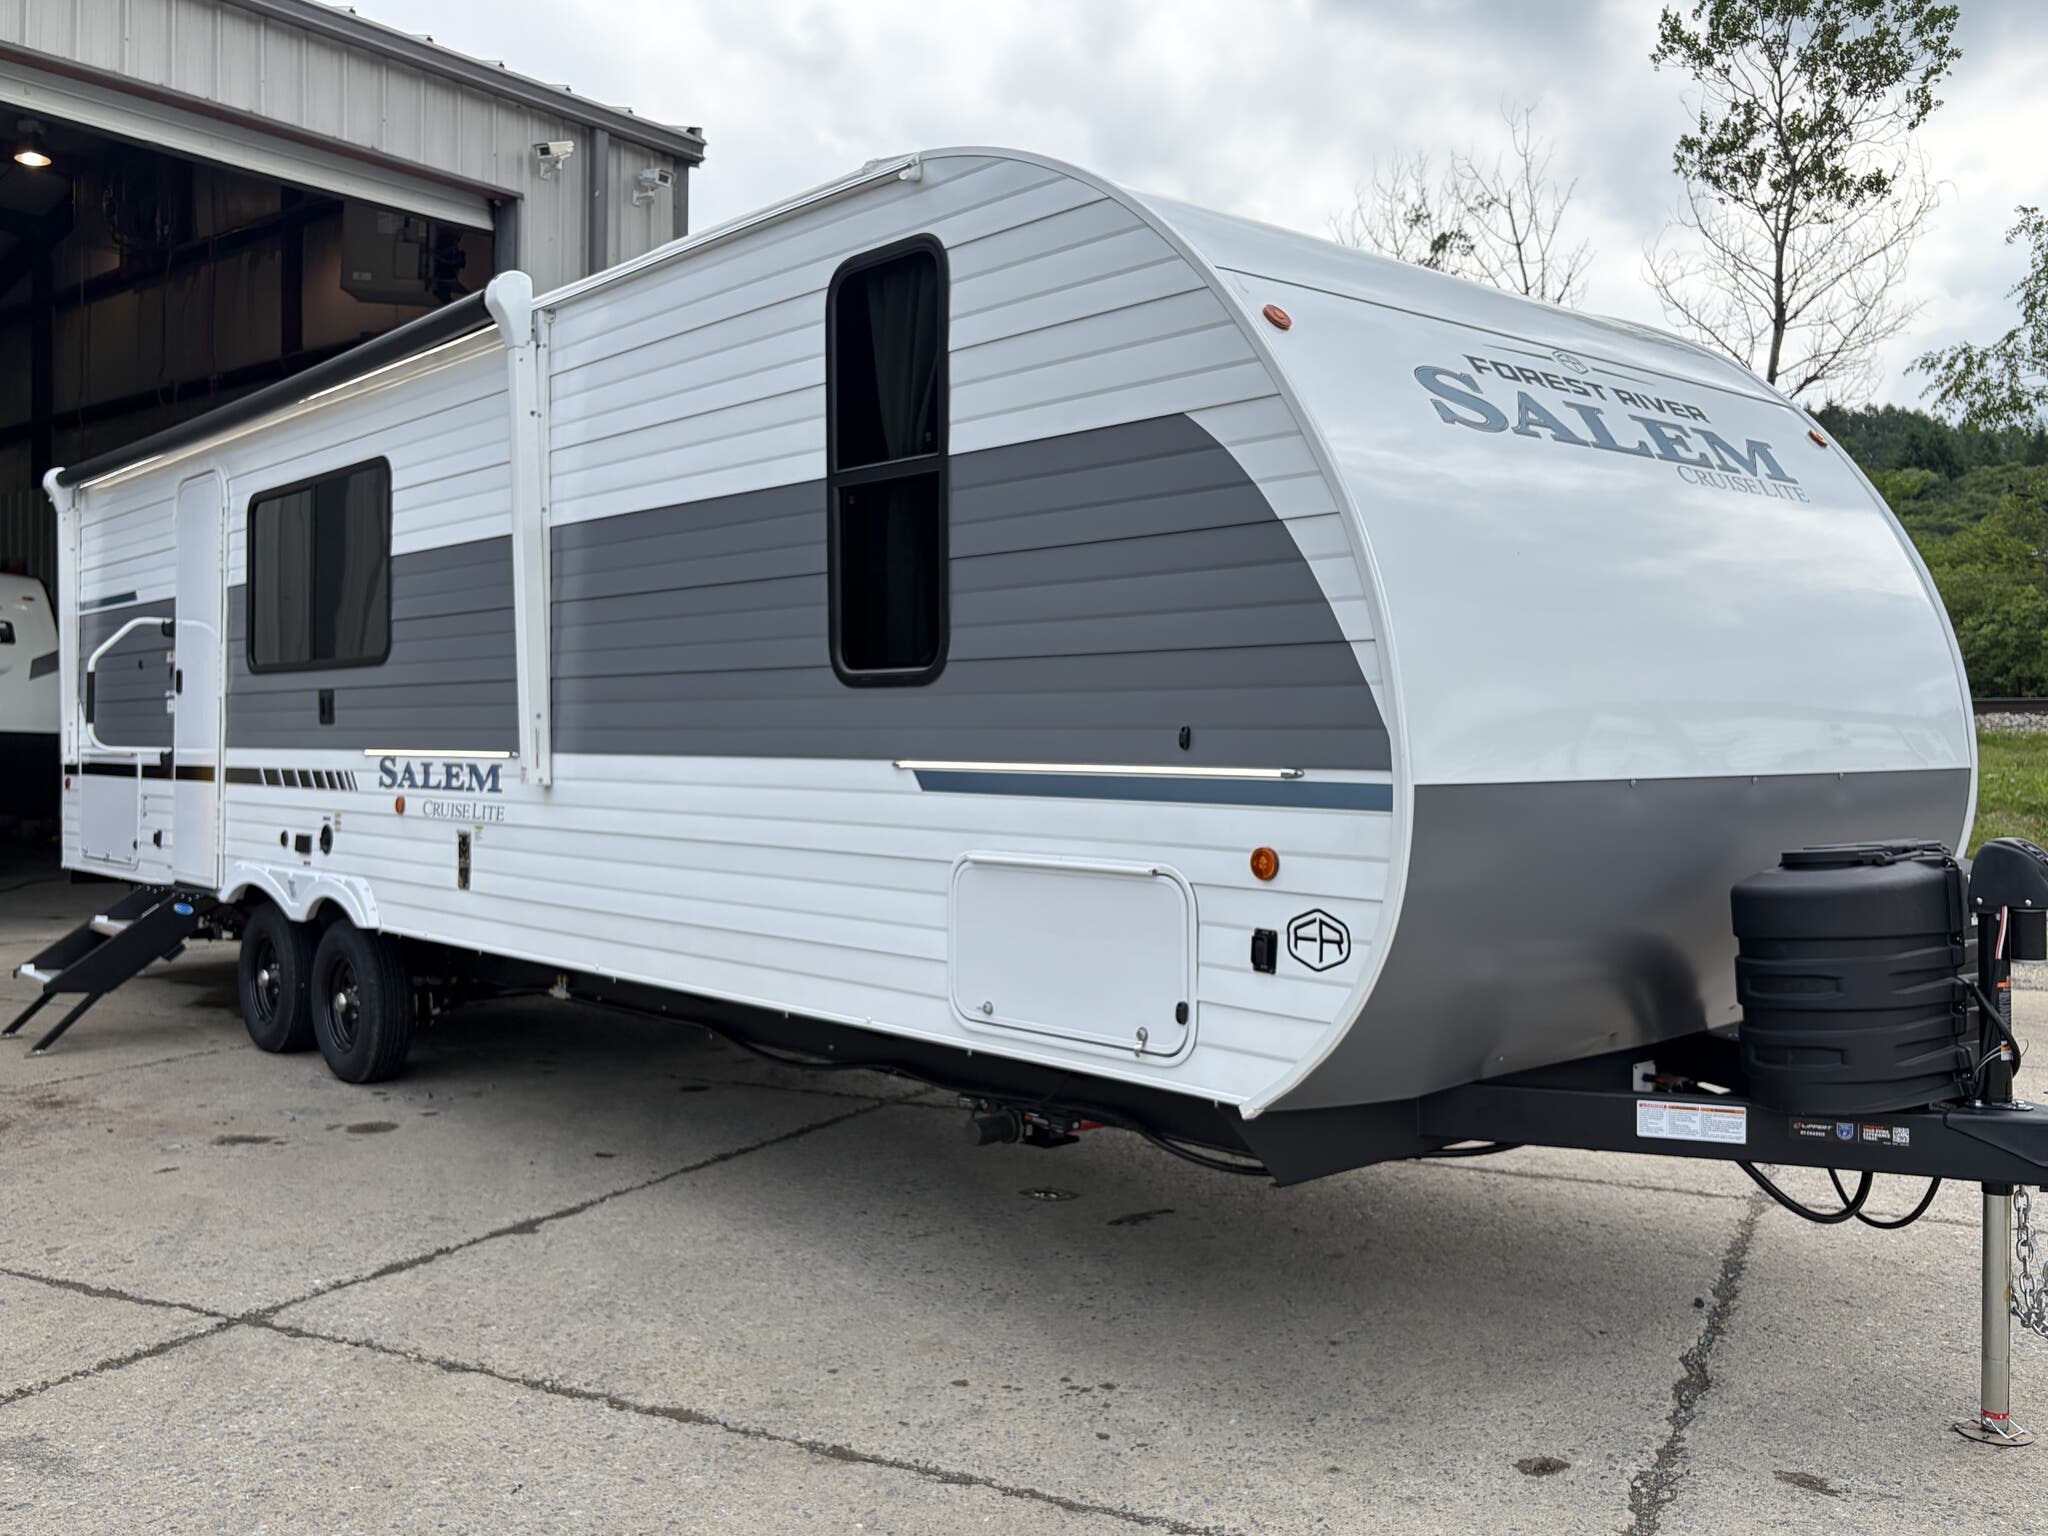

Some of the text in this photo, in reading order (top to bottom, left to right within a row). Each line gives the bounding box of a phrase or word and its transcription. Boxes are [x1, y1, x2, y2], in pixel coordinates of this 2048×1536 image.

[1462, 354, 1711, 424] FOREST RIVER
[1414, 365, 1799, 485] SALEM
[379, 756, 503, 793] SALEM
